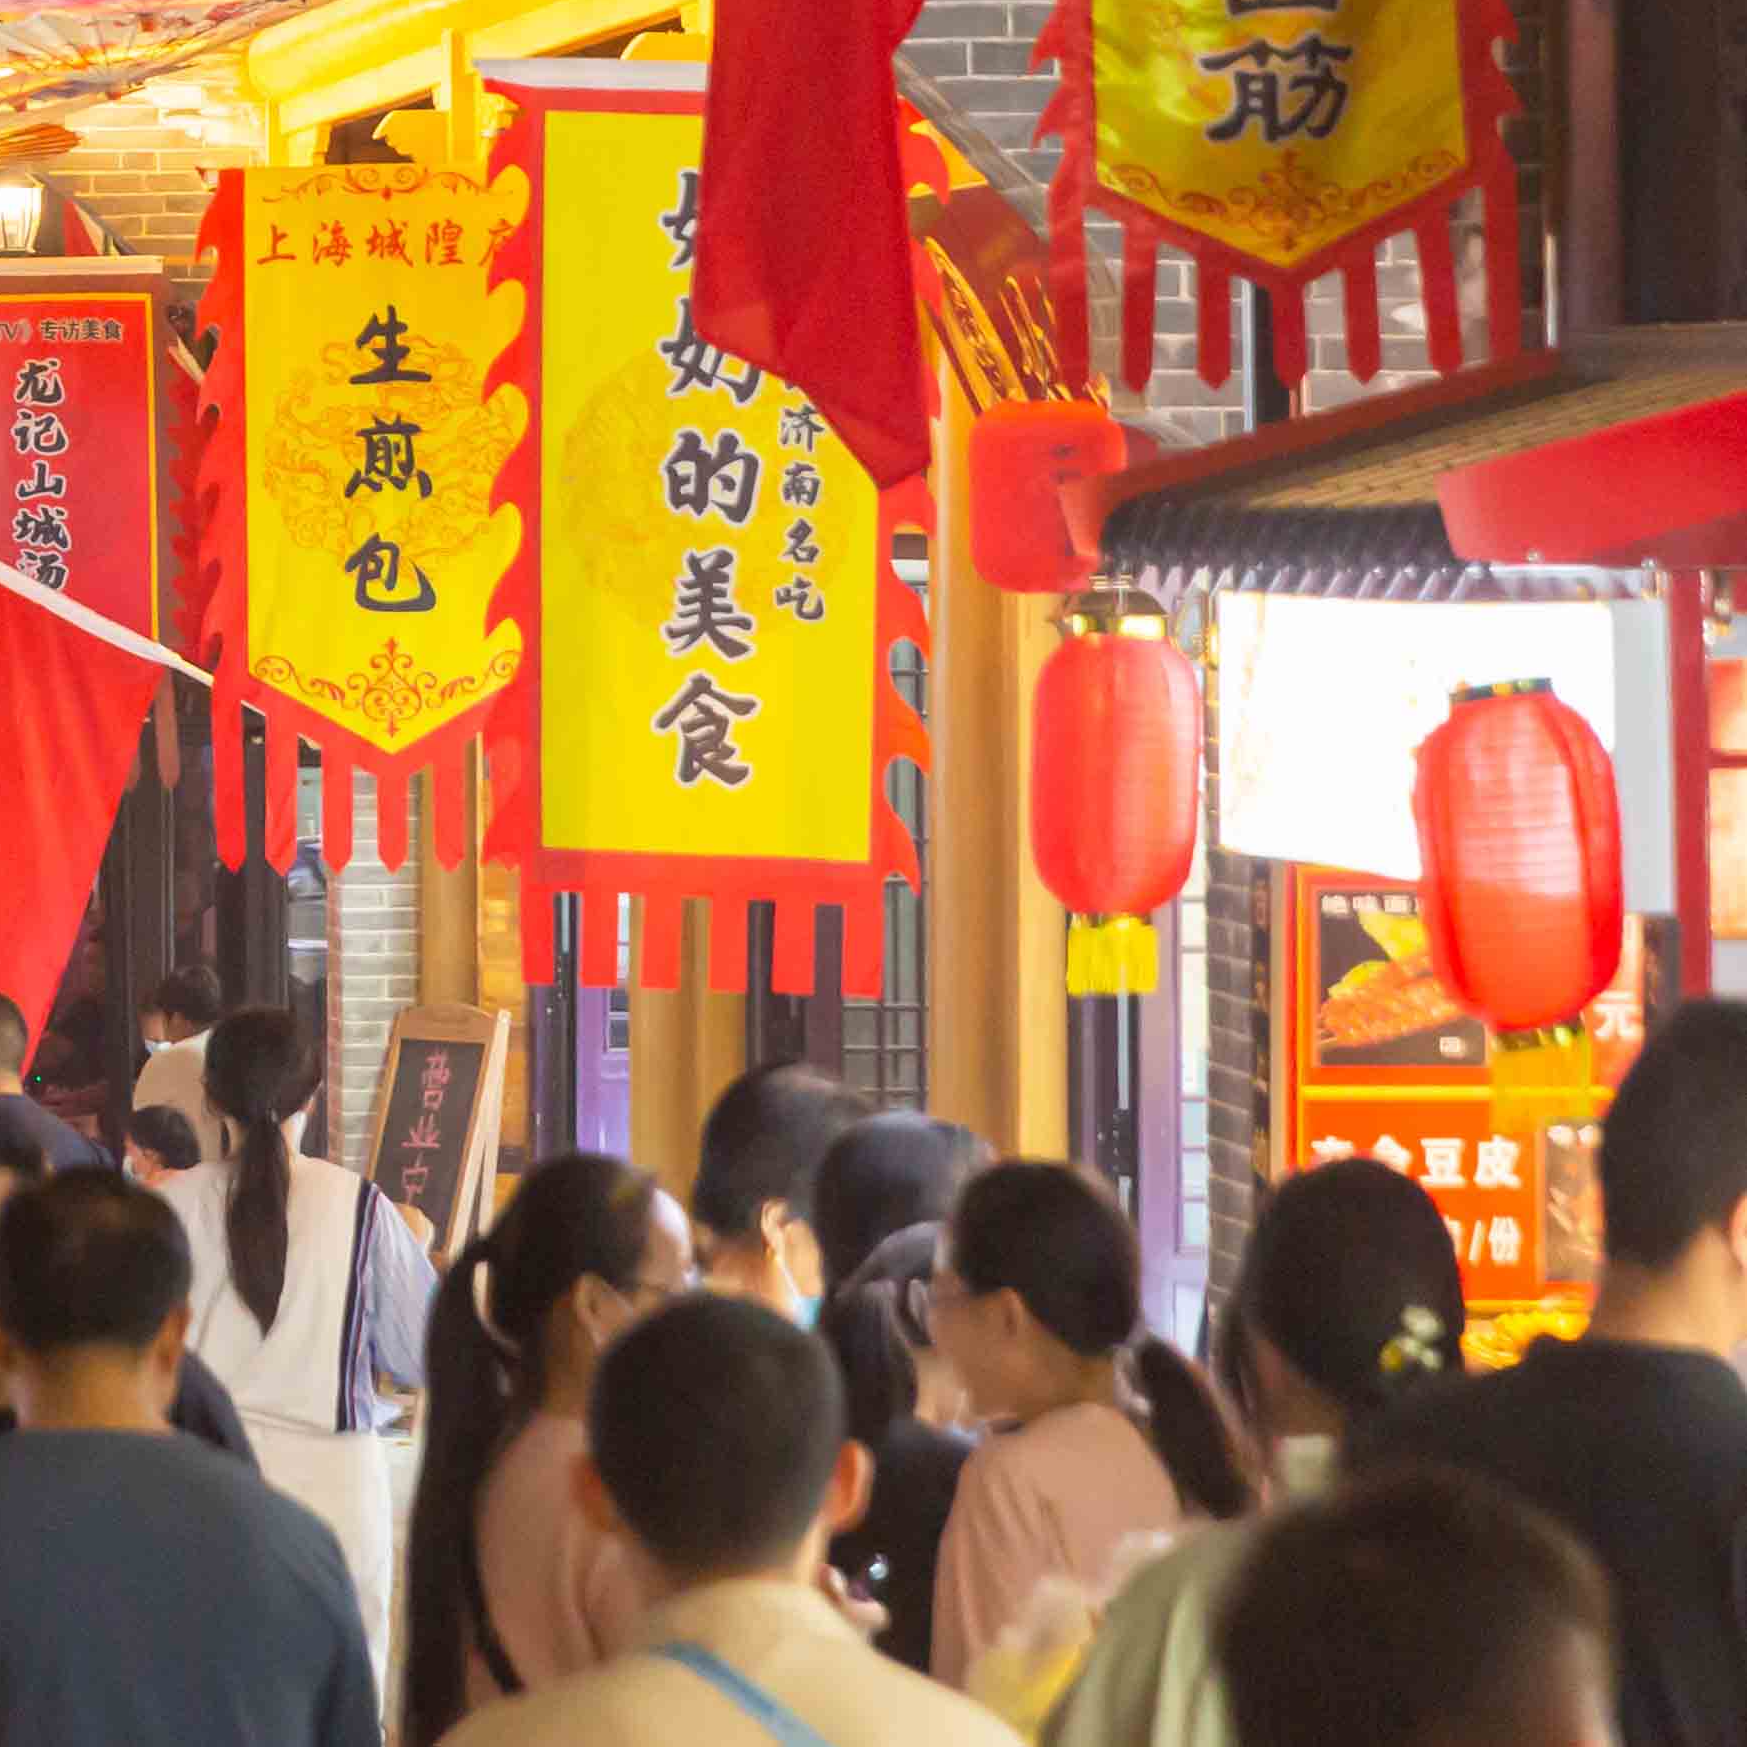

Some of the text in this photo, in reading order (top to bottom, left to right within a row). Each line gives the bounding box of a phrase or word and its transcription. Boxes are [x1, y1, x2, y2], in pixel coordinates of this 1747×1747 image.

[40, 318, 123, 343] 专访美食
[344, 304, 436, 613] 生煎包
[775, 374, 826, 622] 济南名吃
